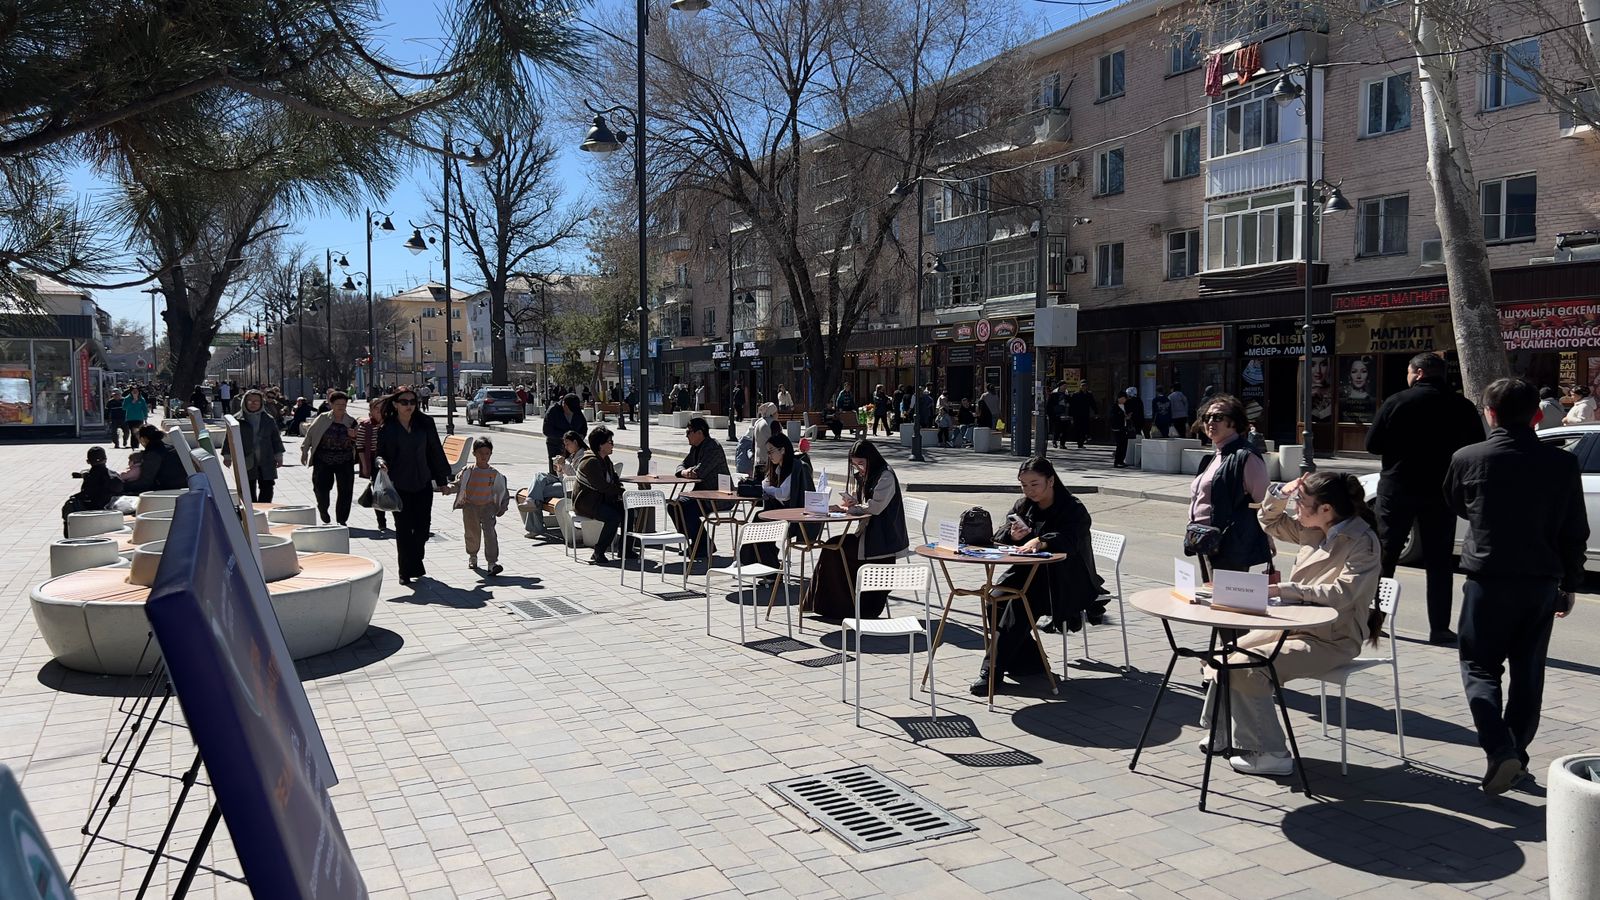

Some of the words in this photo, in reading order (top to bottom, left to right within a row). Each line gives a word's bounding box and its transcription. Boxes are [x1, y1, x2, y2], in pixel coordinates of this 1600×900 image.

[1335, 294, 1389, 308] ЛОМБАРД
[1391, 288, 1448, 304] МАГНИТТ
[1504, 307, 1555, 319] ШҰЖЫҒЫ
[1370, 325, 1435, 340] МАГНИТТ
[1500, 328, 1552, 340] МАШНЯЯ
[1554, 326, 1600, 338] КОЛБАС
[1284, 345, 1327, 355] ЛОМРД
[1370, 339, 1433, 351] ЛОМБАРД
[1502, 337, 1600, 350] ТЬ-КАМЕНОГОРСК
